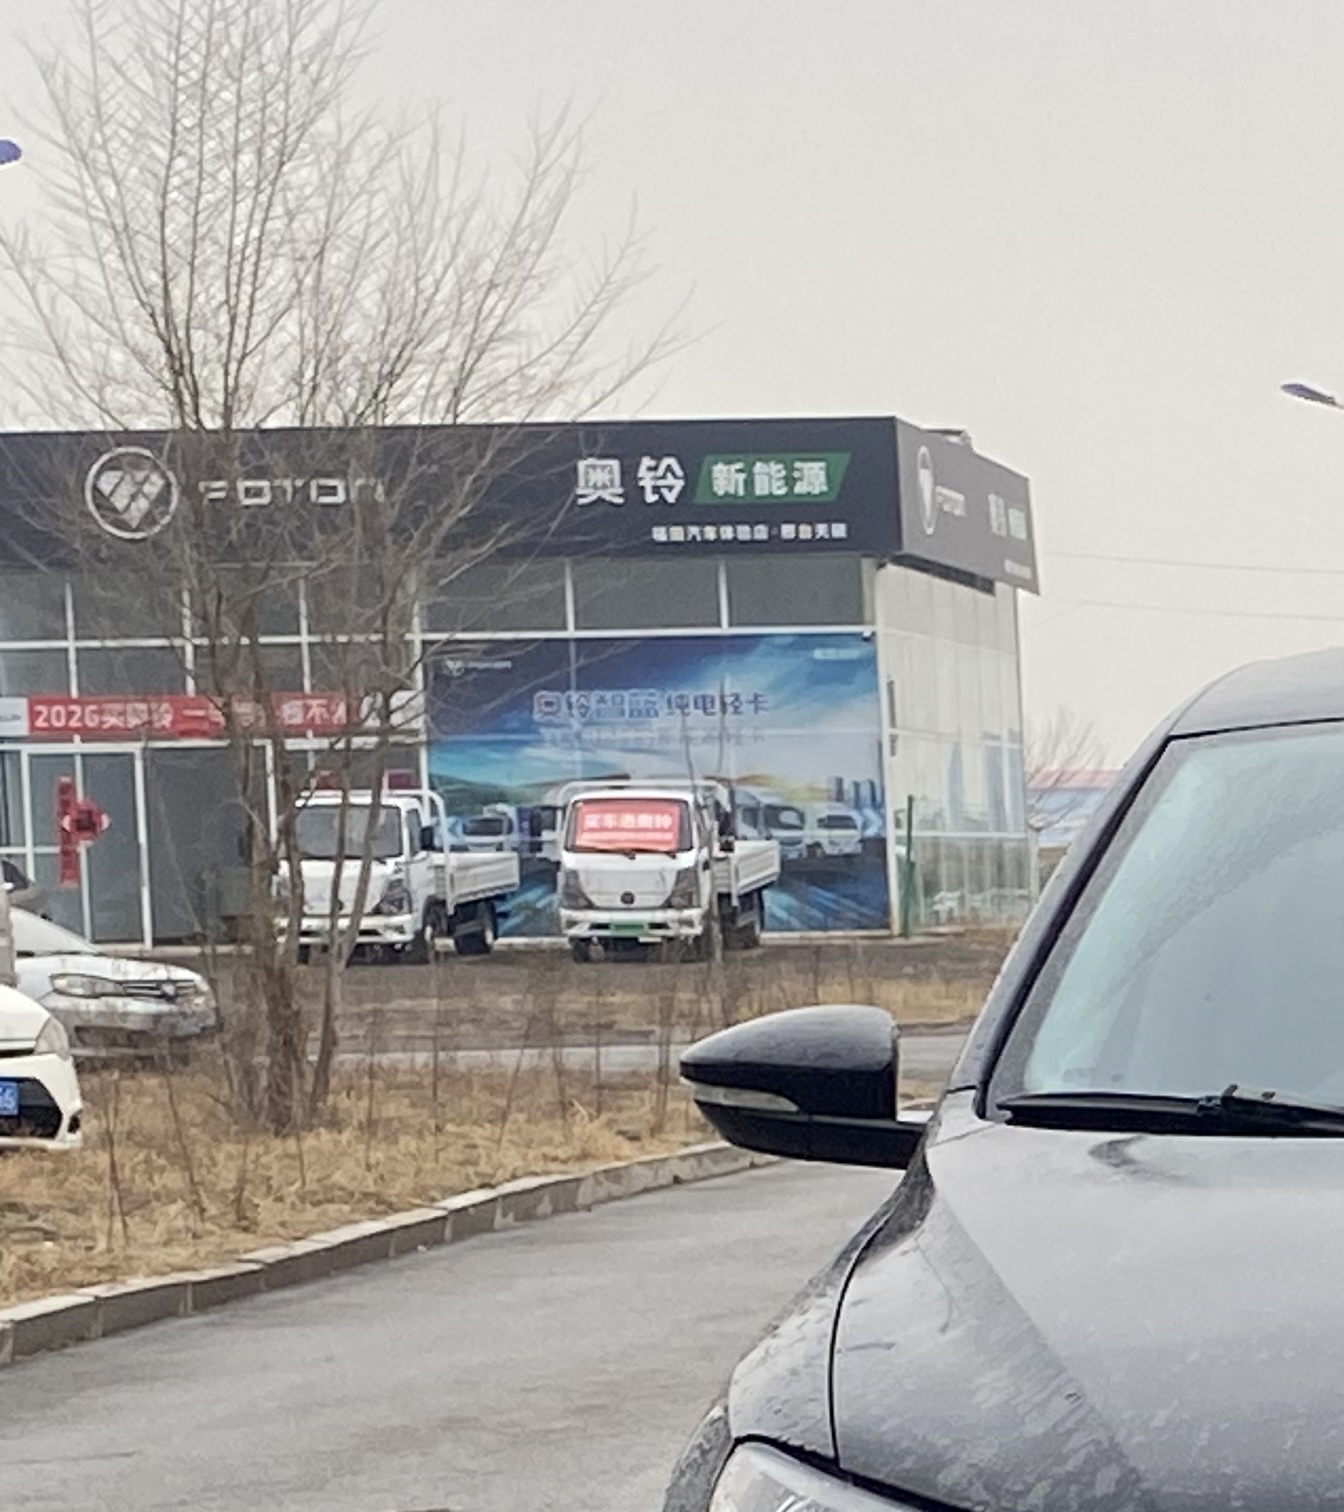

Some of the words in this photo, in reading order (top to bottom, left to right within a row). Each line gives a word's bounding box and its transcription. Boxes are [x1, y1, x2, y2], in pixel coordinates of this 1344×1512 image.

[576, 456, 685, 505] 奥铃
[711, 461, 828, 496] 新能源
